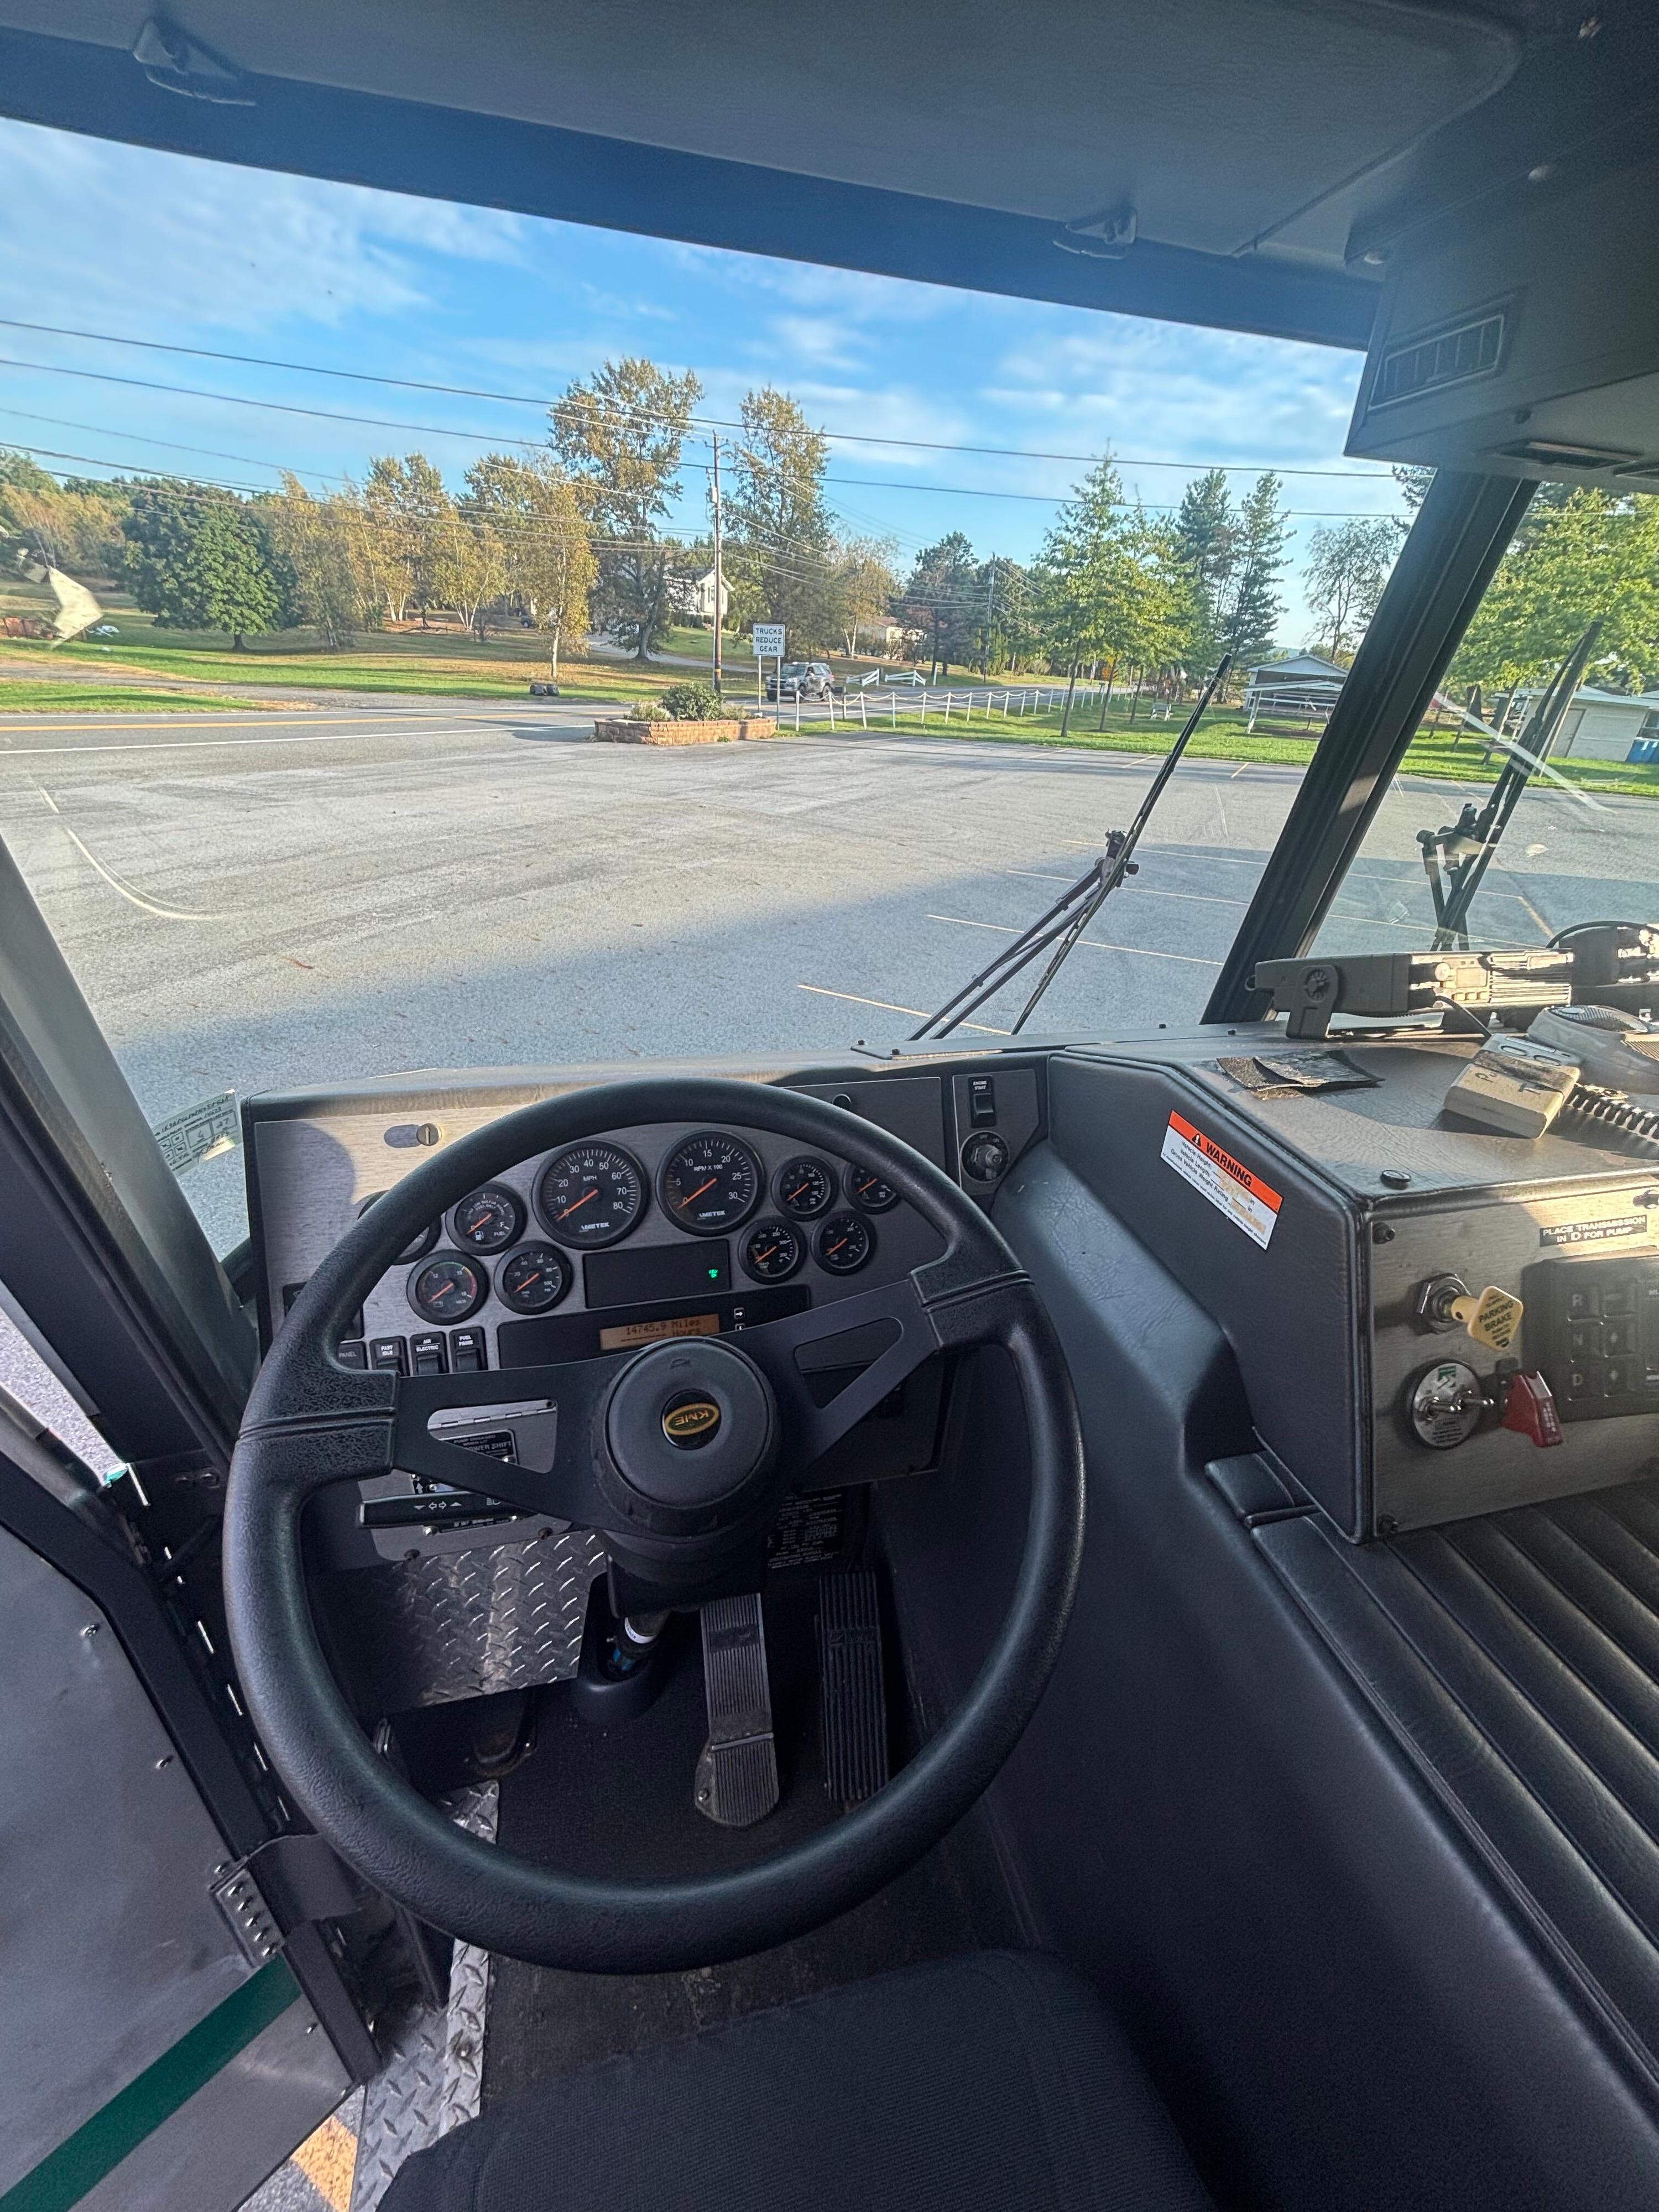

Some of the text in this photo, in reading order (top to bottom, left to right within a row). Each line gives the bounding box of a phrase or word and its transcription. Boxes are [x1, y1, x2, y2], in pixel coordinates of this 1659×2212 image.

[1180, 1147, 1194, 1164] Vehicle
[1194, 1161, 1211, 1178] Length:
[1181, 1140, 1196, 1156] Vehicle
[1197, 1153, 1212, 1170] Height:
[599, 1162, 609, 1170] 50
[1205, 1141, 1253, 1187] WARNING
[1171, 1148, 1228, 1202] Gross Vehicle Weight Rating
[557, 1195, 566, 1203] 10
[1543, 1216, 1645, 1236] PLACE TRANSMISSION
[1571, 1232, 1581, 1241] D
[1584, 1230, 1604, 1239] FOR
[1606, 1227, 1632, 1236] PUMP
[1572, 1294, 1583, 1307] R
[1479, 1300, 1513, 1323] PARKING
[626, 1319, 701, 1335] 14745.9 Miles
[1485, 1312, 1512, 1331] BRAKE
[1572, 1373, 1583, 1386] D
[491, 1441, 512, 1449] SHIFT
